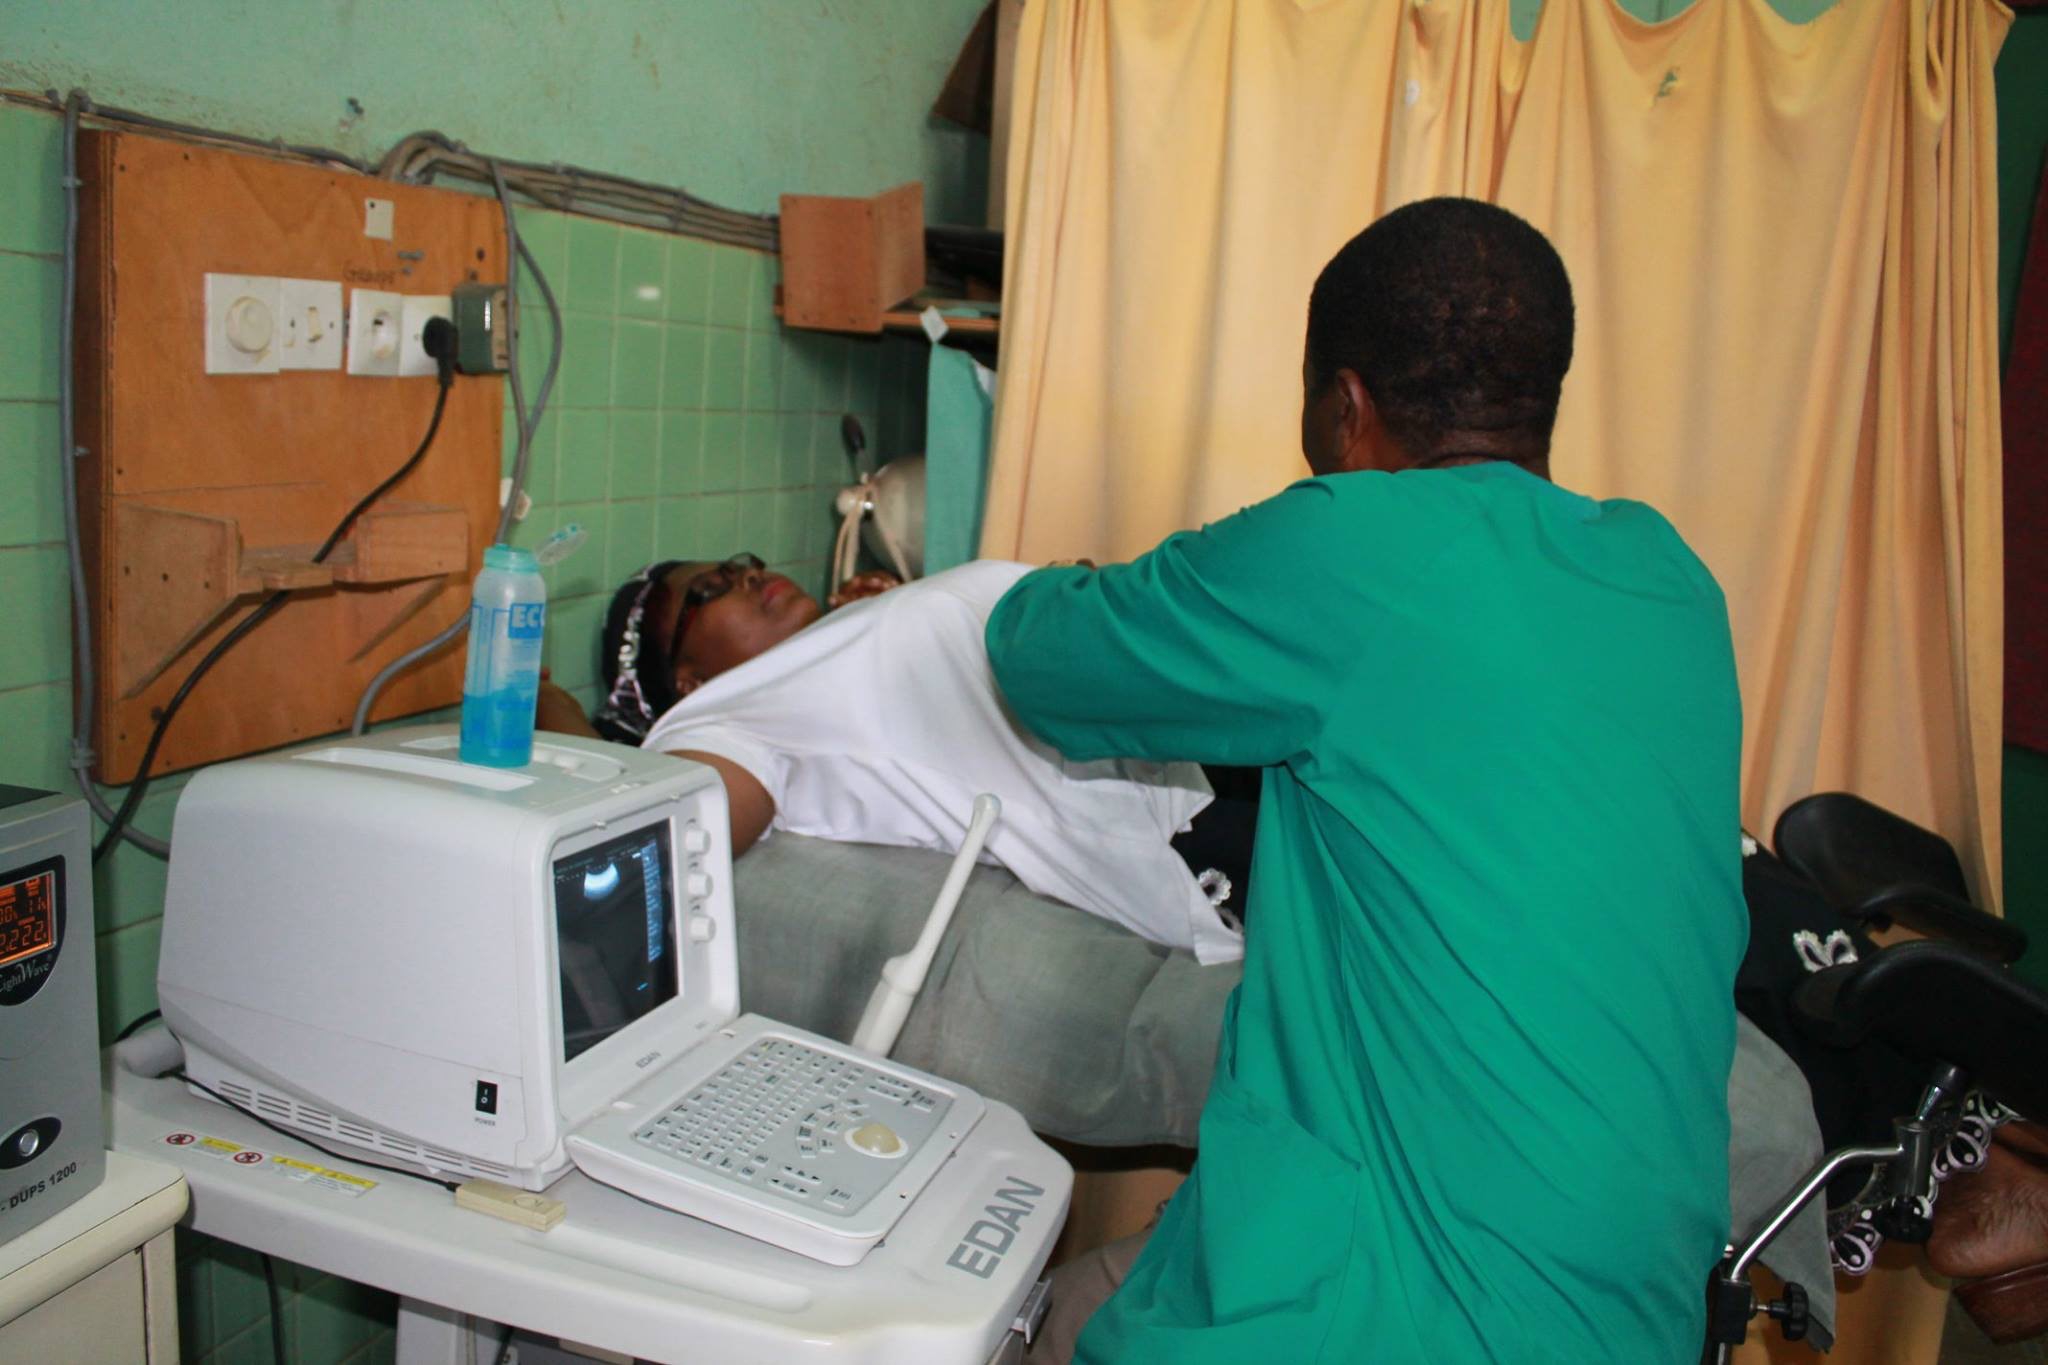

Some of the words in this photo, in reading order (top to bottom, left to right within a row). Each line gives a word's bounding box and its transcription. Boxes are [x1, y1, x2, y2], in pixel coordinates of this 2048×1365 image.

[511, 605, 544, 628] EC
[10, 1180, 45, 1208] DUPS
[49, 1162, 77, 1185] 1200
[945, 1175, 1045, 1279] EDAN
